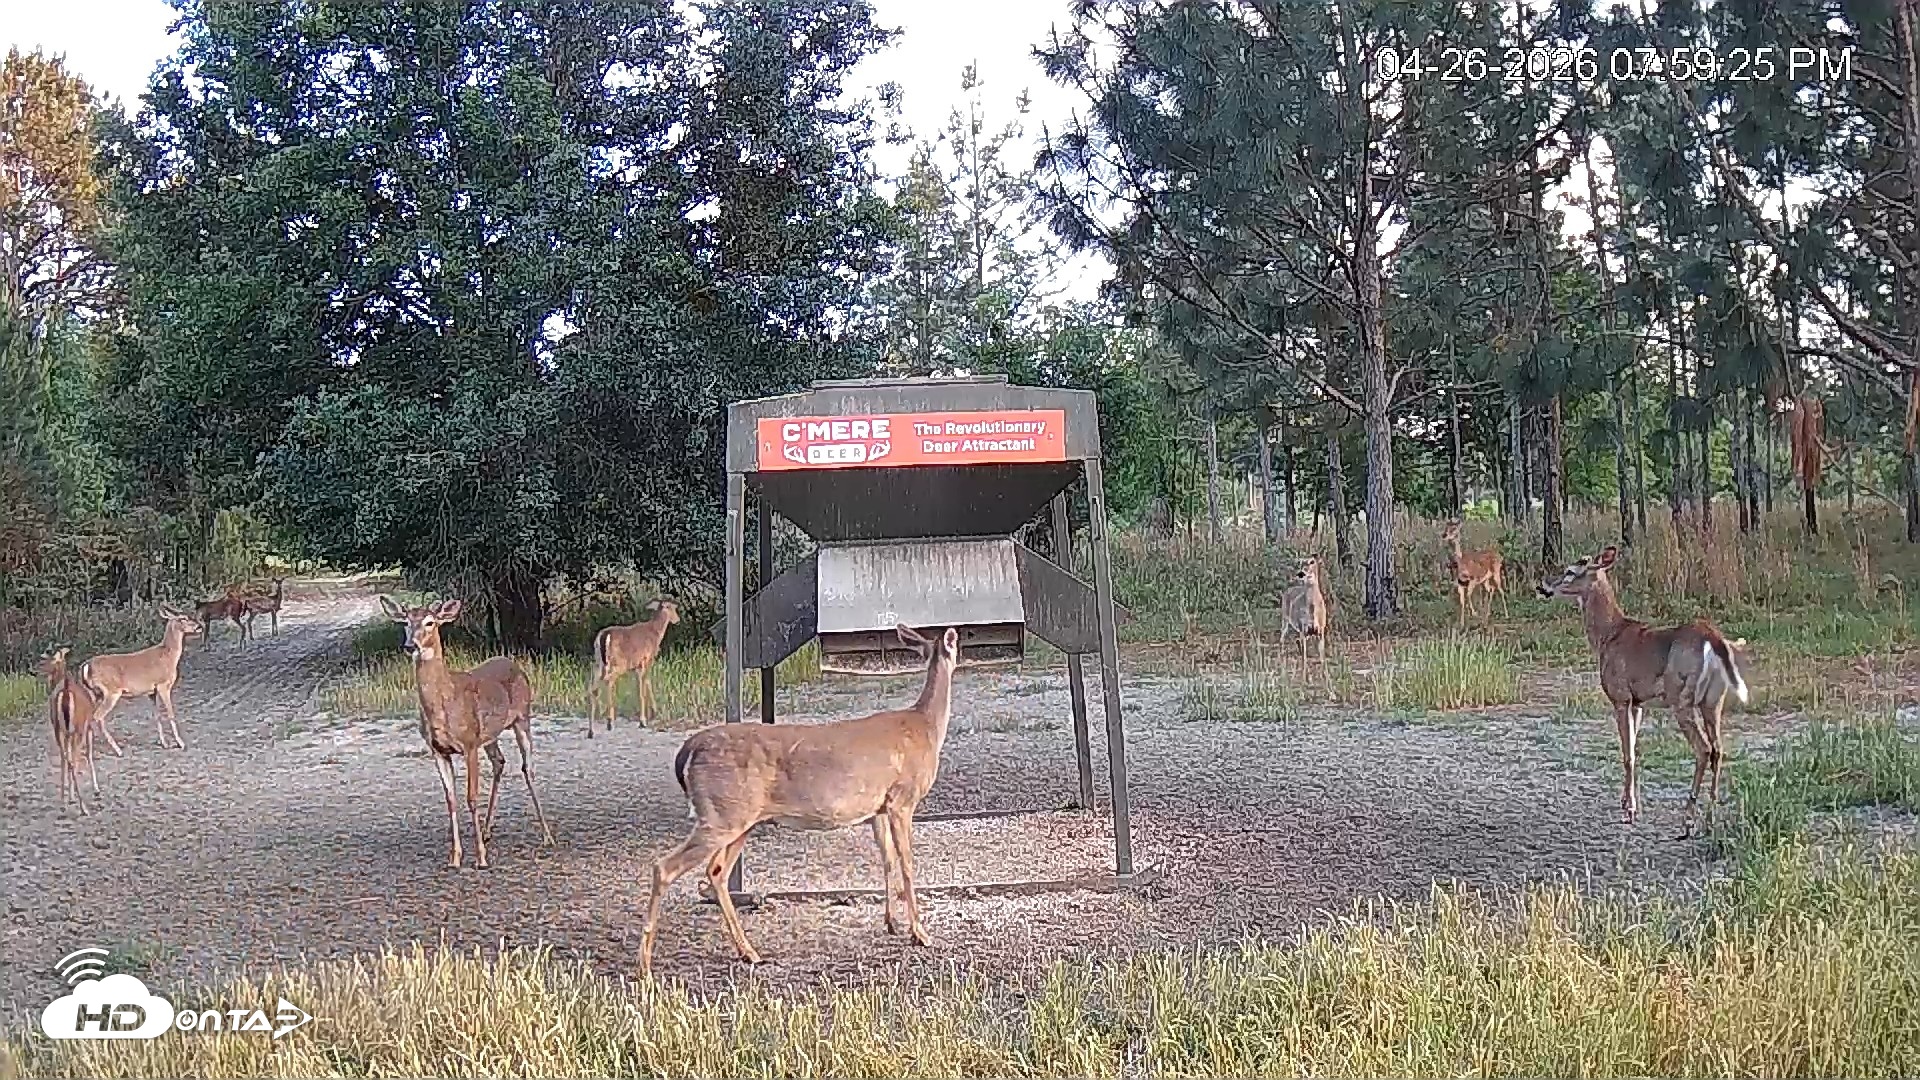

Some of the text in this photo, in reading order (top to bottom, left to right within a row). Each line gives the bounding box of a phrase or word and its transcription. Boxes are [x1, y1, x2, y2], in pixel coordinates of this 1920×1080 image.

[782, 419, 891, 442] C'MERE
[914, 420, 1046, 436] The Revolutionary
[922, 438, 1036, 453] Deer Attractant
[813, 448, 862, 461] DEER
